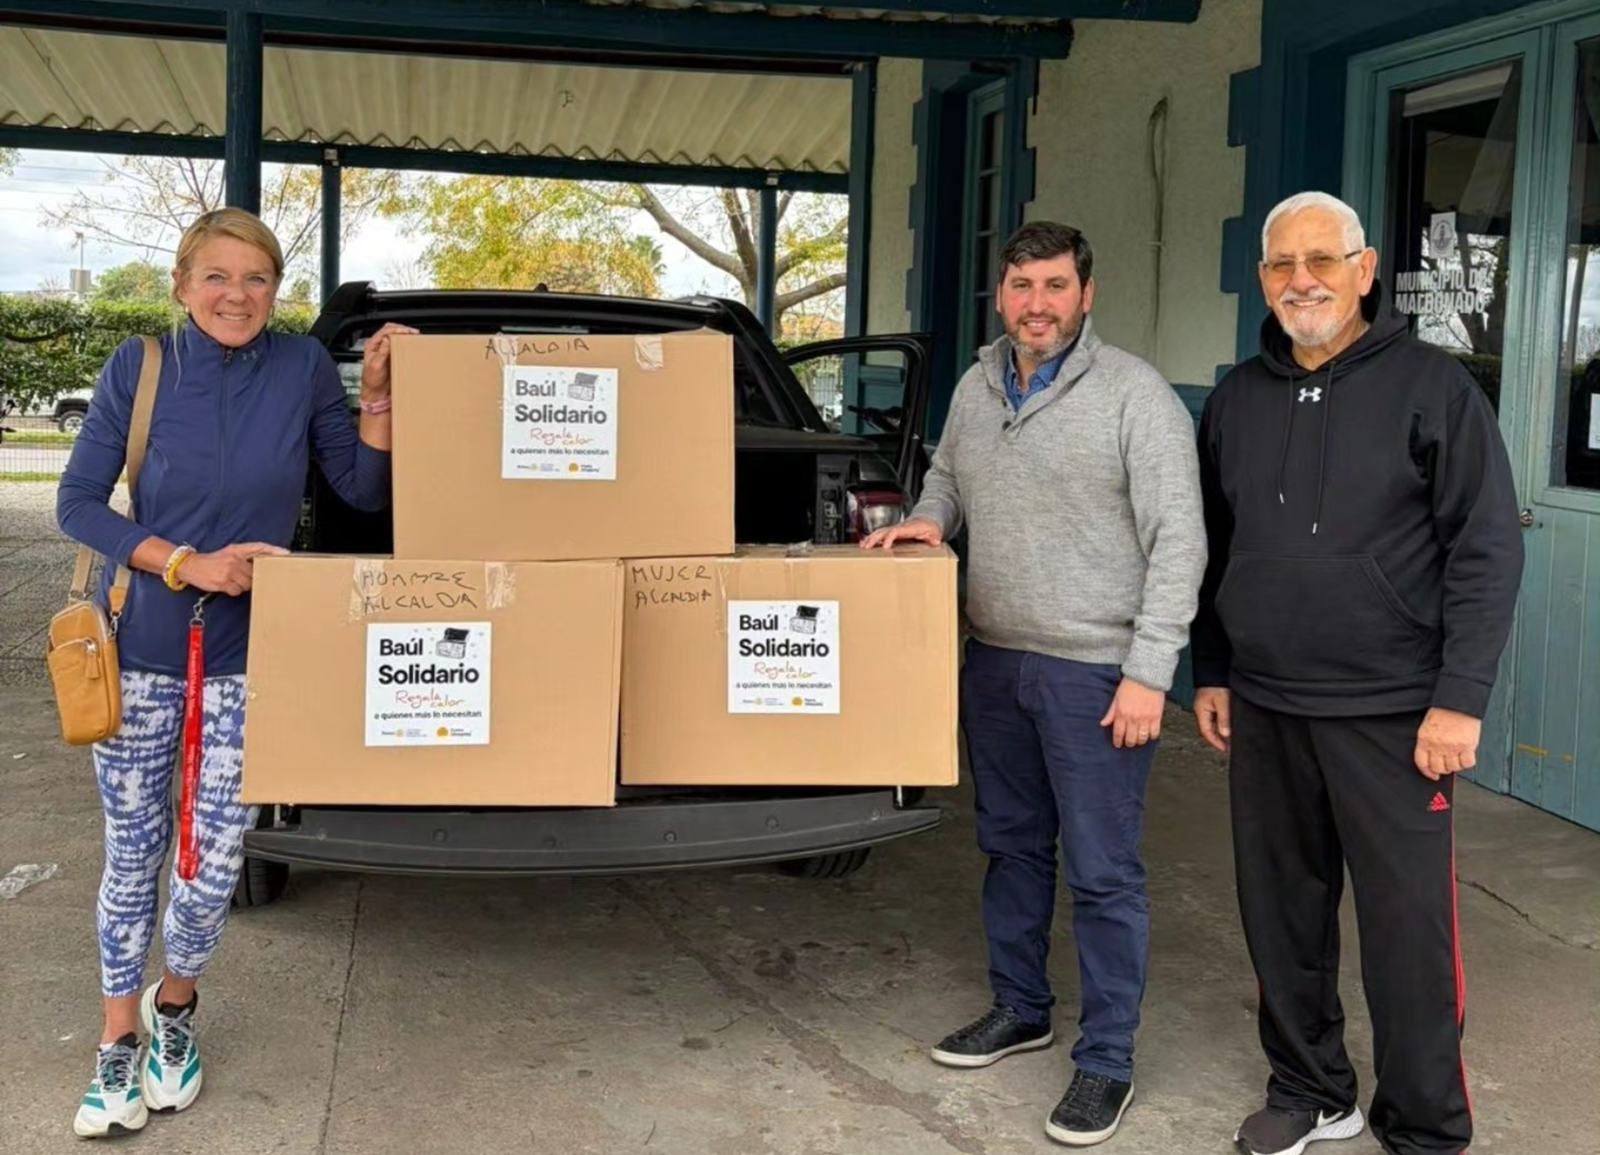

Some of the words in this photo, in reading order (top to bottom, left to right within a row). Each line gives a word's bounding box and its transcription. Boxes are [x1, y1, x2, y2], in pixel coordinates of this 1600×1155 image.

[1396, 269, 1465, 292] MUNICIPIO
[1395, 291, 1485, 315] MALDONADO
[515, 379, 556, 397] Baúl
[515, 404, 607, 424] Solidario
[562, 433, 593, 445] calor
[517, 447, 546, 455] quienes
[573, 448, 609, 456] necesitan
[632, 565, 712, 583] MUJER
[740, 613, 778, 631] Baúl
[380, 637, 423, 656] Baúl
[739, 638, 830, 657] Solidario
[378, 663, 479, 684] Solidario
[786, 667, 818, 679] calor
[742, 681, 771, 690] quienes
[788, 681, 795, 689] lo
[430, 694, 466, 708] calor
[381, 711, 413, 720] quienes
[433, 710, 440, 718] lo
[442, 710, 482, 719] necesitan
